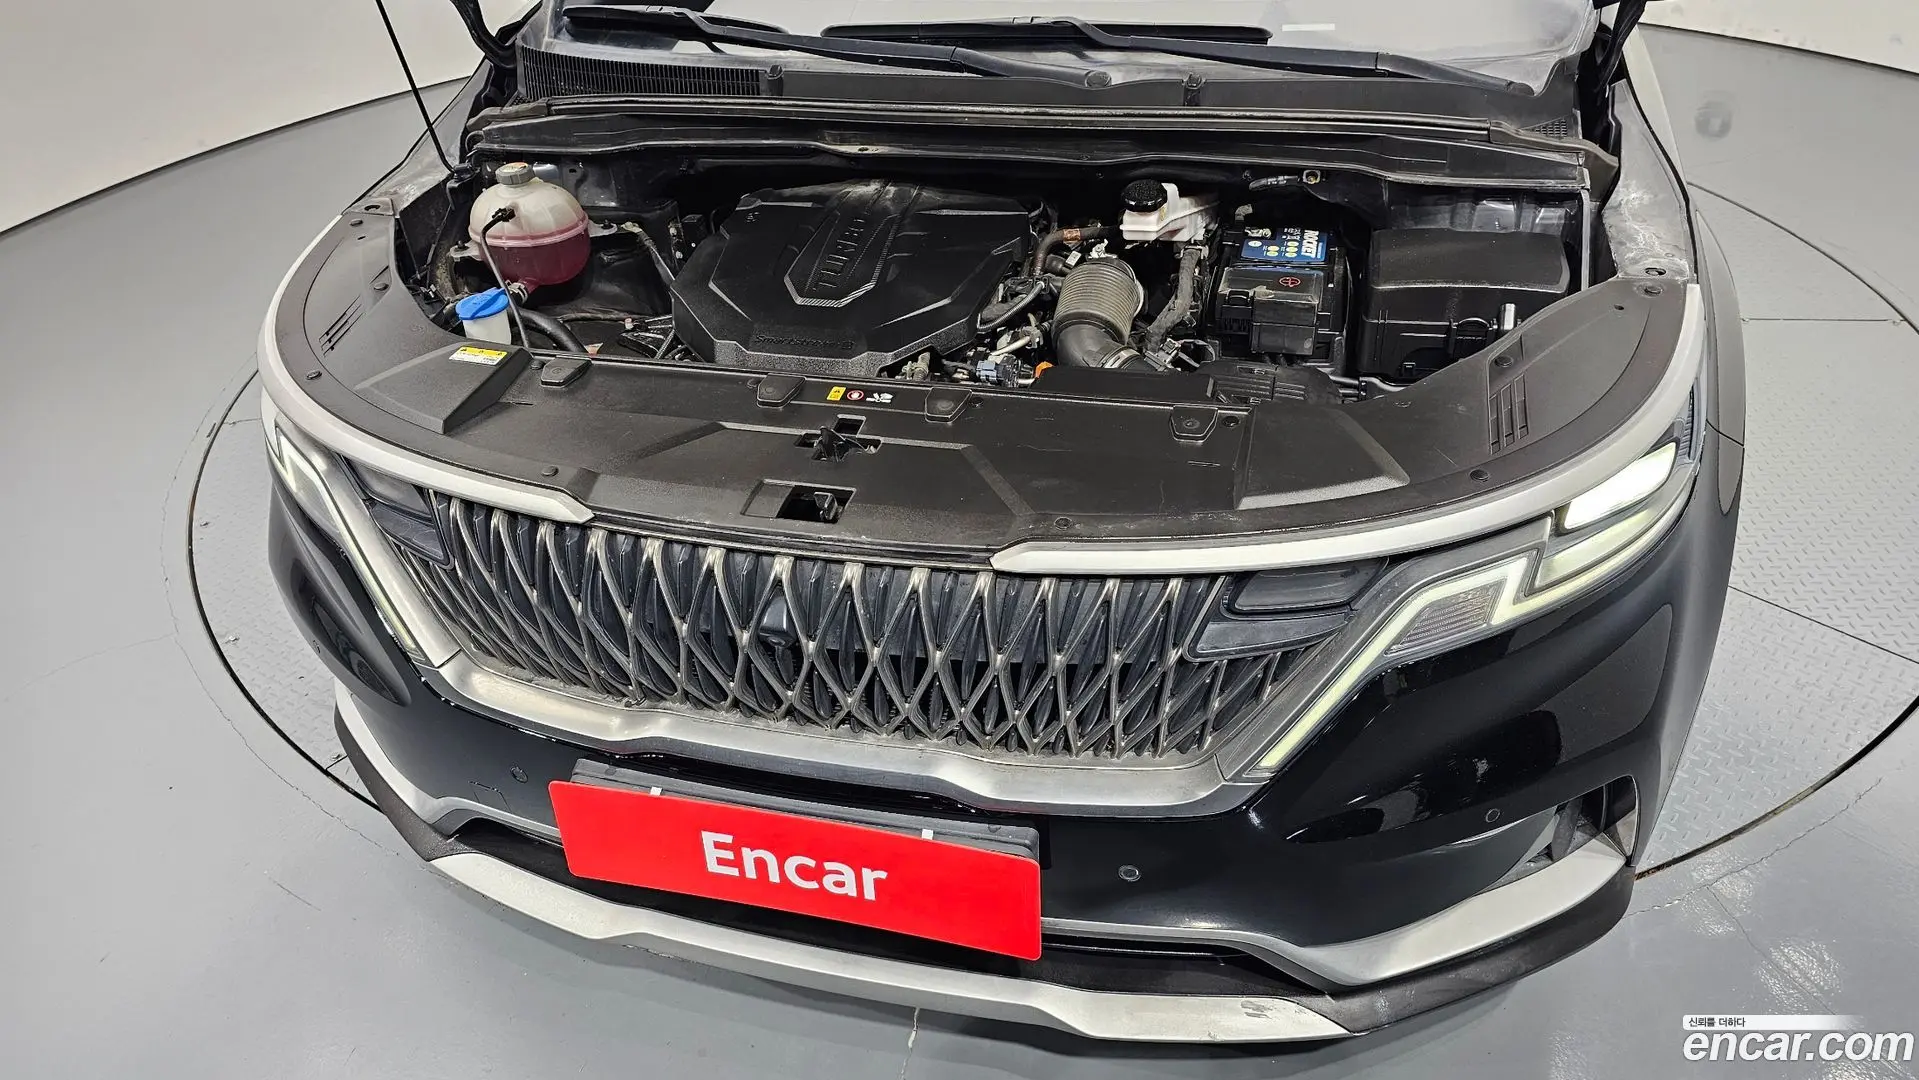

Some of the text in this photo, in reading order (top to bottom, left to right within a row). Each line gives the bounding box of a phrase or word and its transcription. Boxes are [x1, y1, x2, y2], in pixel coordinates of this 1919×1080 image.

[812, 216, 867, 291] TURBO
[1301, 229, 1320, 258] ROCKET
[701, 830, 888, 901] Encar
